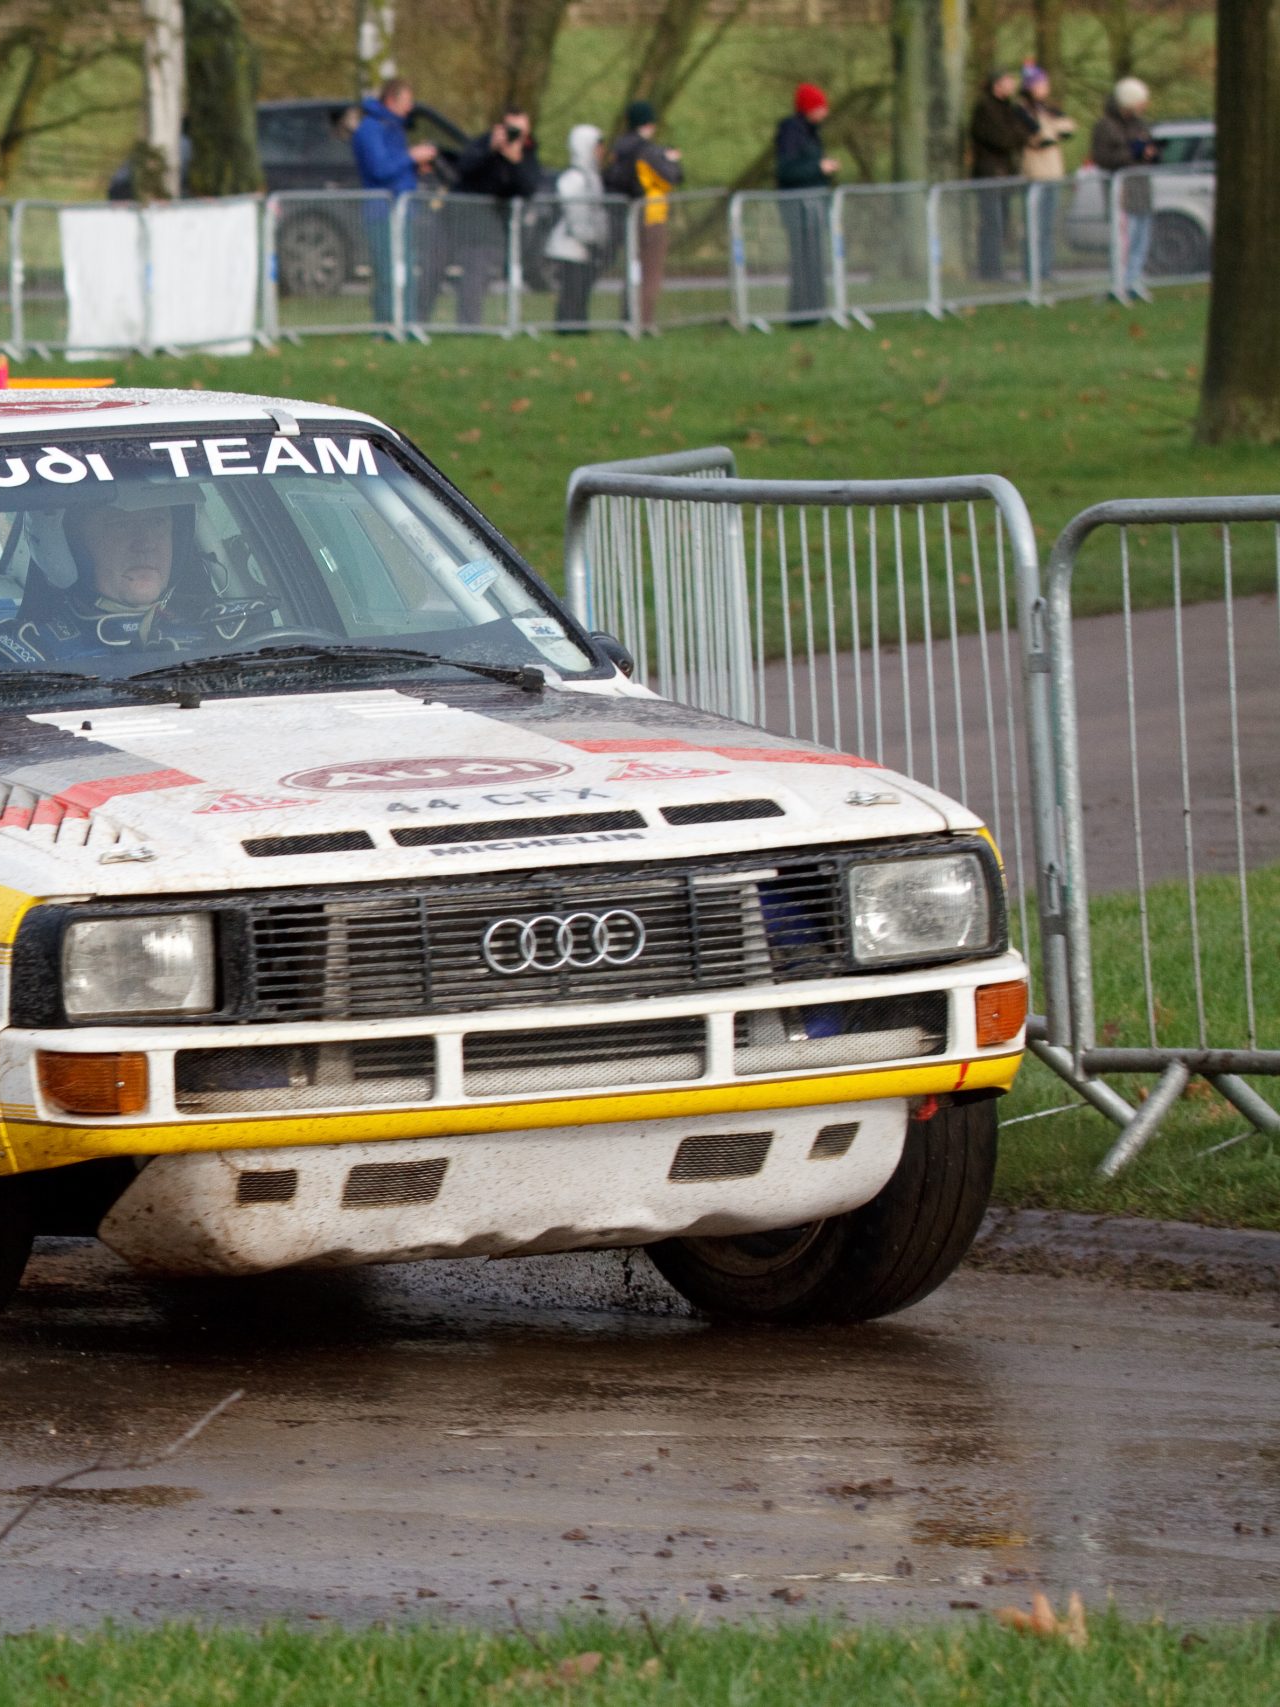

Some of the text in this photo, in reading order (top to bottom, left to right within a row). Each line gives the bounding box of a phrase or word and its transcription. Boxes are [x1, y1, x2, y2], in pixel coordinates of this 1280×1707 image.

[148, 437, 380, 478] TEAM
[386, 787, 612, 815] 44 CFX
[429, 831, 646, 857] MICHELIN
